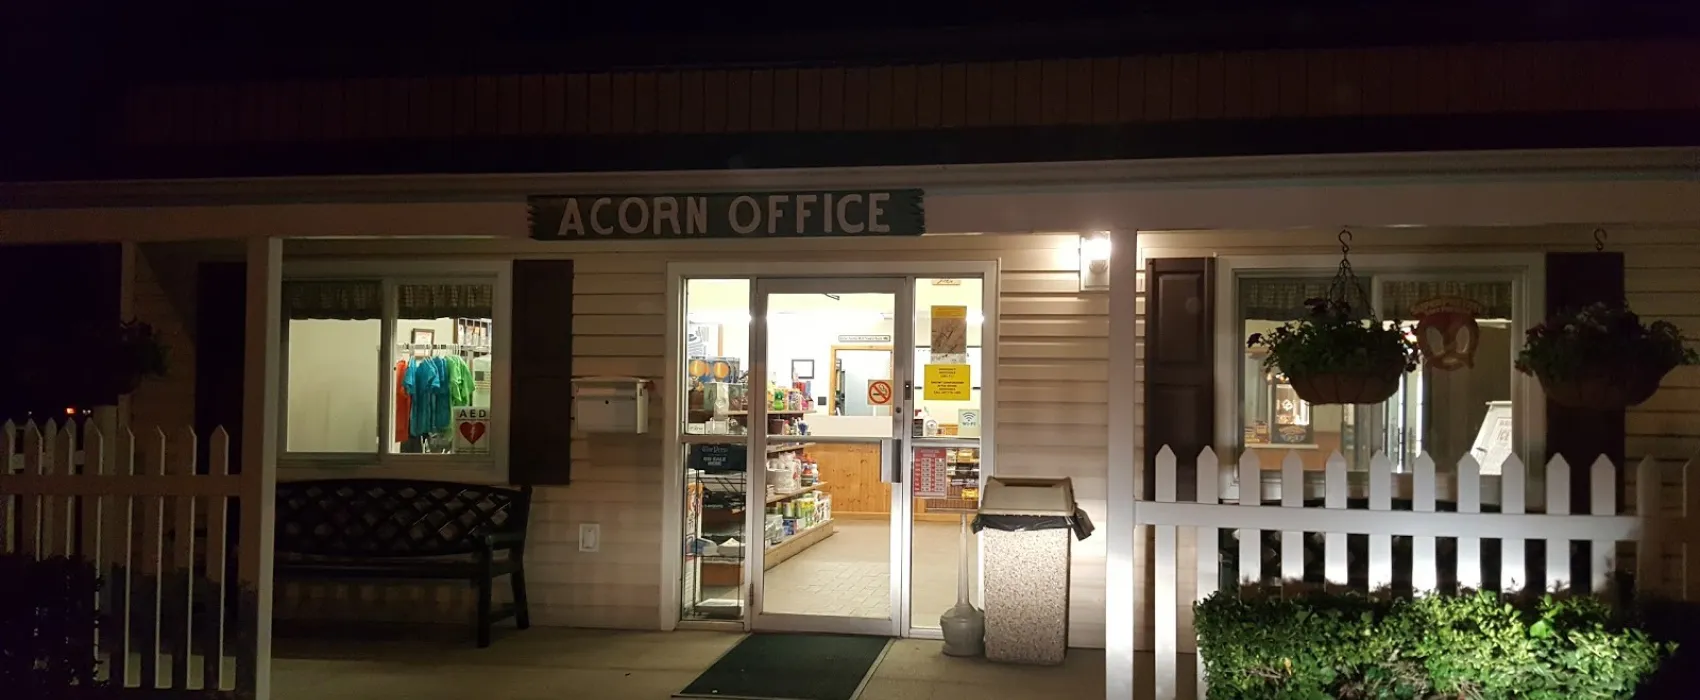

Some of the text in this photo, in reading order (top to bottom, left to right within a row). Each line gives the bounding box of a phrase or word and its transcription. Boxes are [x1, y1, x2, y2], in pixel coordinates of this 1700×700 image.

[557, 193, 891, 236] ACORN OFFICE
[459, 409, 487, 418] AED
